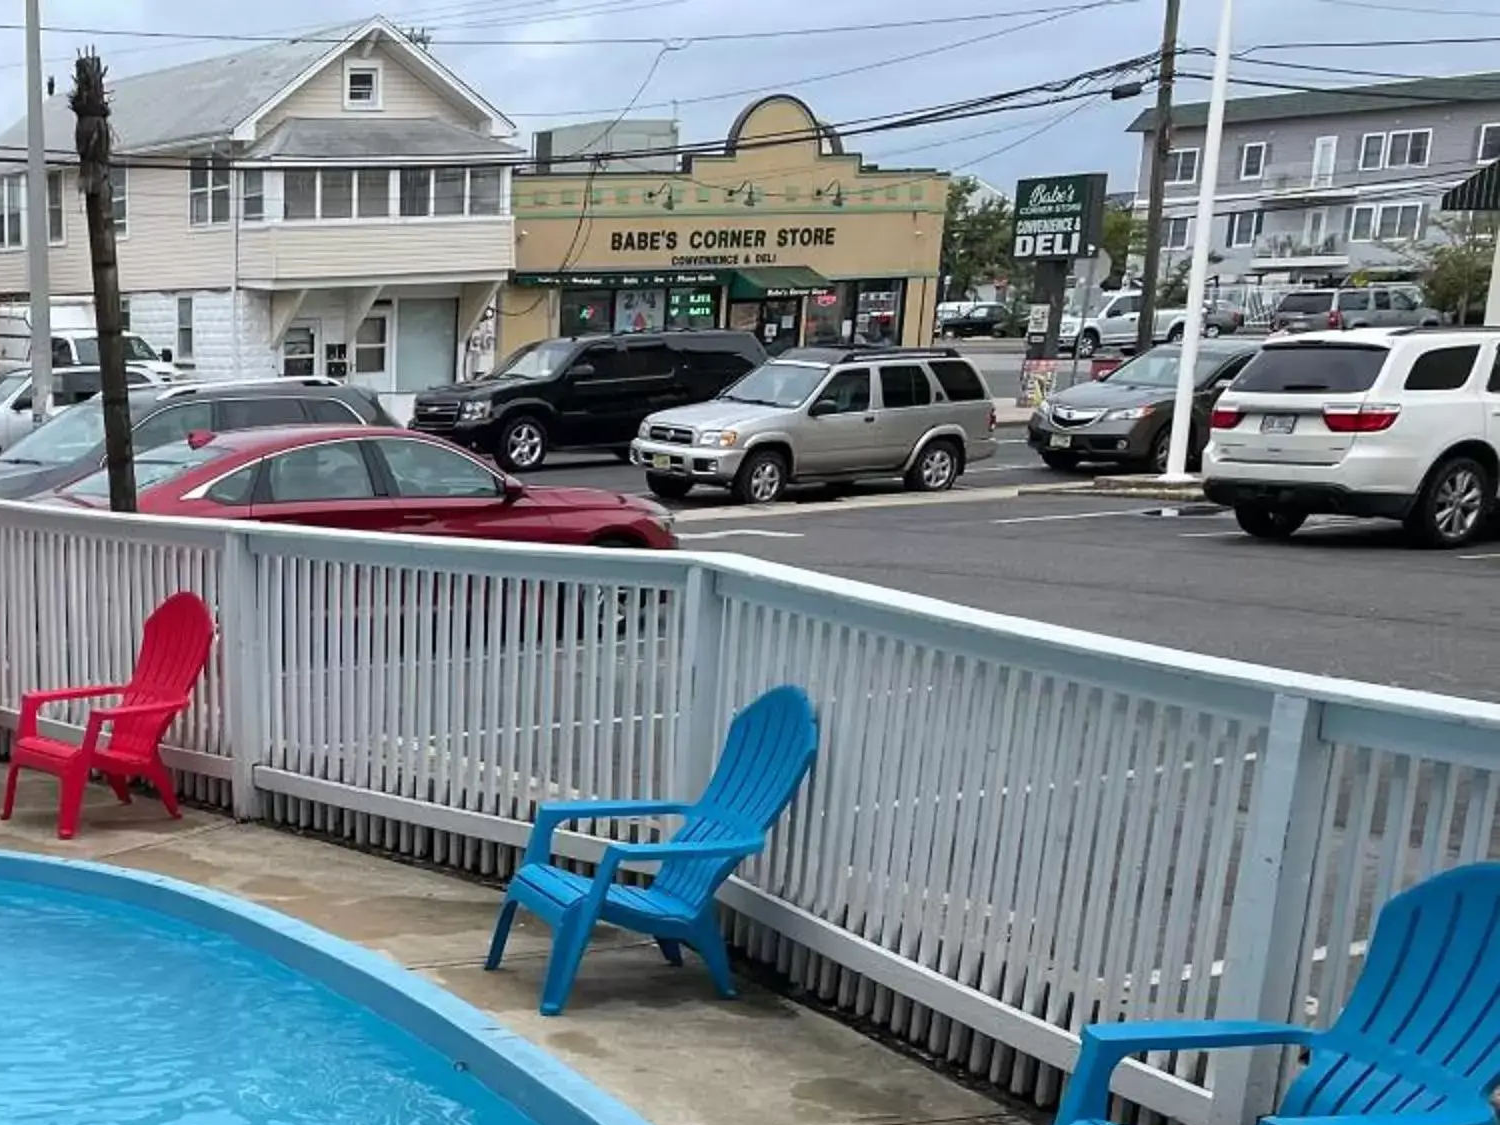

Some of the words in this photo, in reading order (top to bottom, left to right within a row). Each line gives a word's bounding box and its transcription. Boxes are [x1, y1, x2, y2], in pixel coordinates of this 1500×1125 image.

[1029, 184, 1075, 206] Babe's
[1016, 217, 1074, 234] CONVENIENCE
[611, 230, 677, 250] BABE'S
[690, 230, 766, 249] CORNER
[777, 228, 836, 247] STORE
[1013, 232, 1080, 257] DELI
[671, 254, 739, 266] CONVENIENCE
[755, 253, 777, 264] DELI
